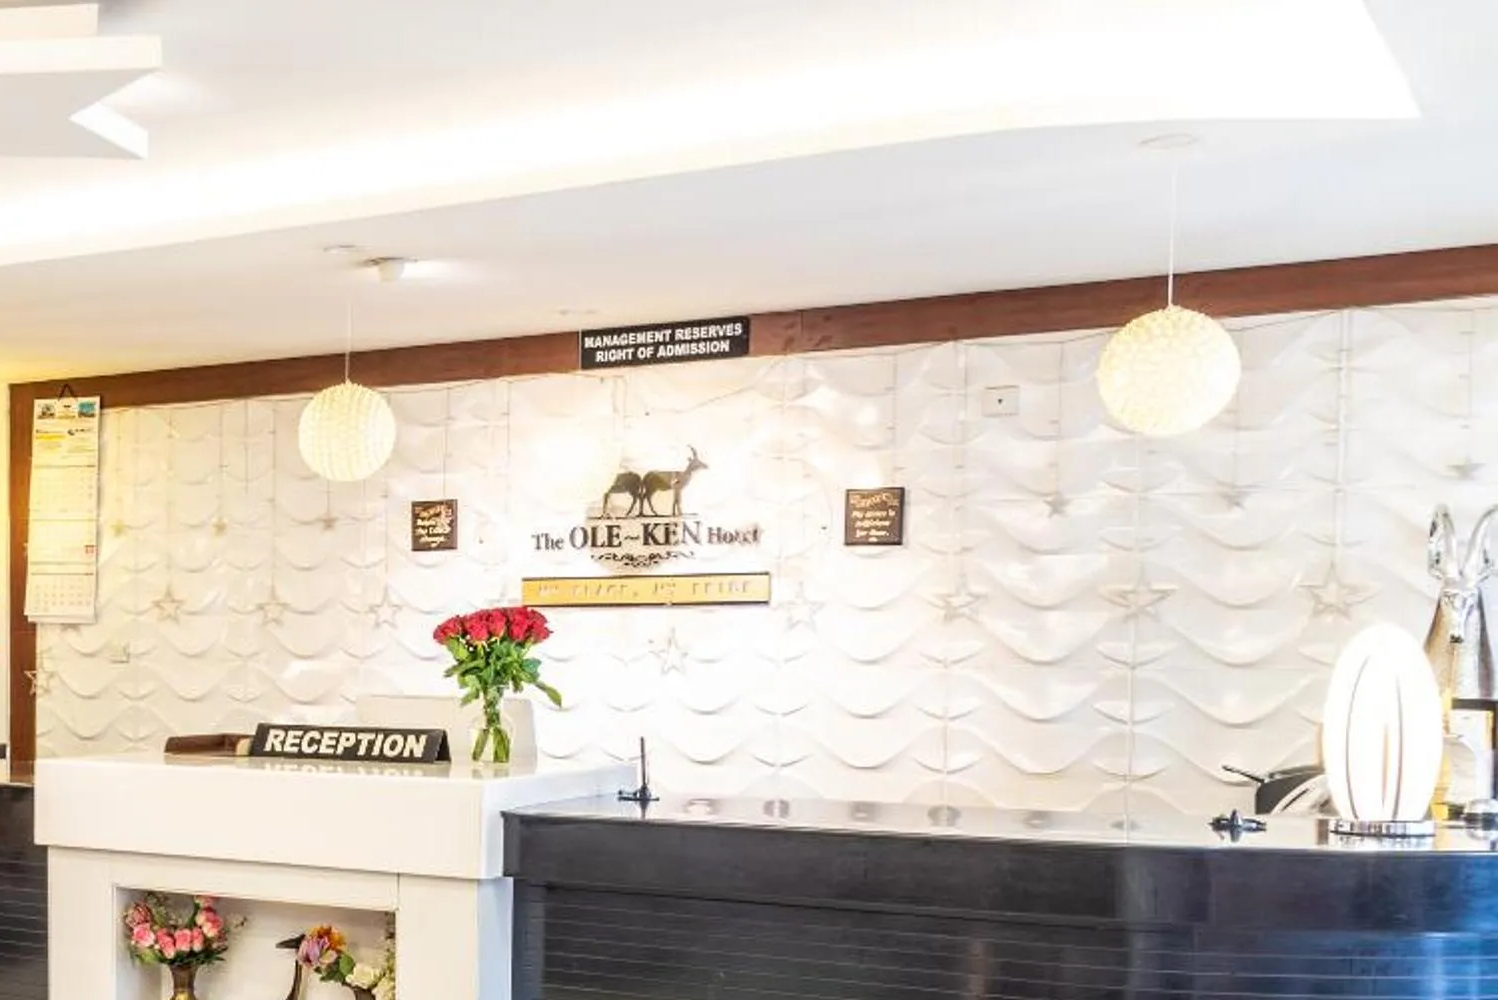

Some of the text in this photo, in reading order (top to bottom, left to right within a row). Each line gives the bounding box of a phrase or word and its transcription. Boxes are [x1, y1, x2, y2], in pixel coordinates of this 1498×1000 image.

[584, 322, 743, 349] MANAGEMENT RESERVES
[595, 340, 731, 363] RIGHT OF ADMISSION
[531, 532, 564, 551] The
[263, 728, 428, 758] RECEPTION
